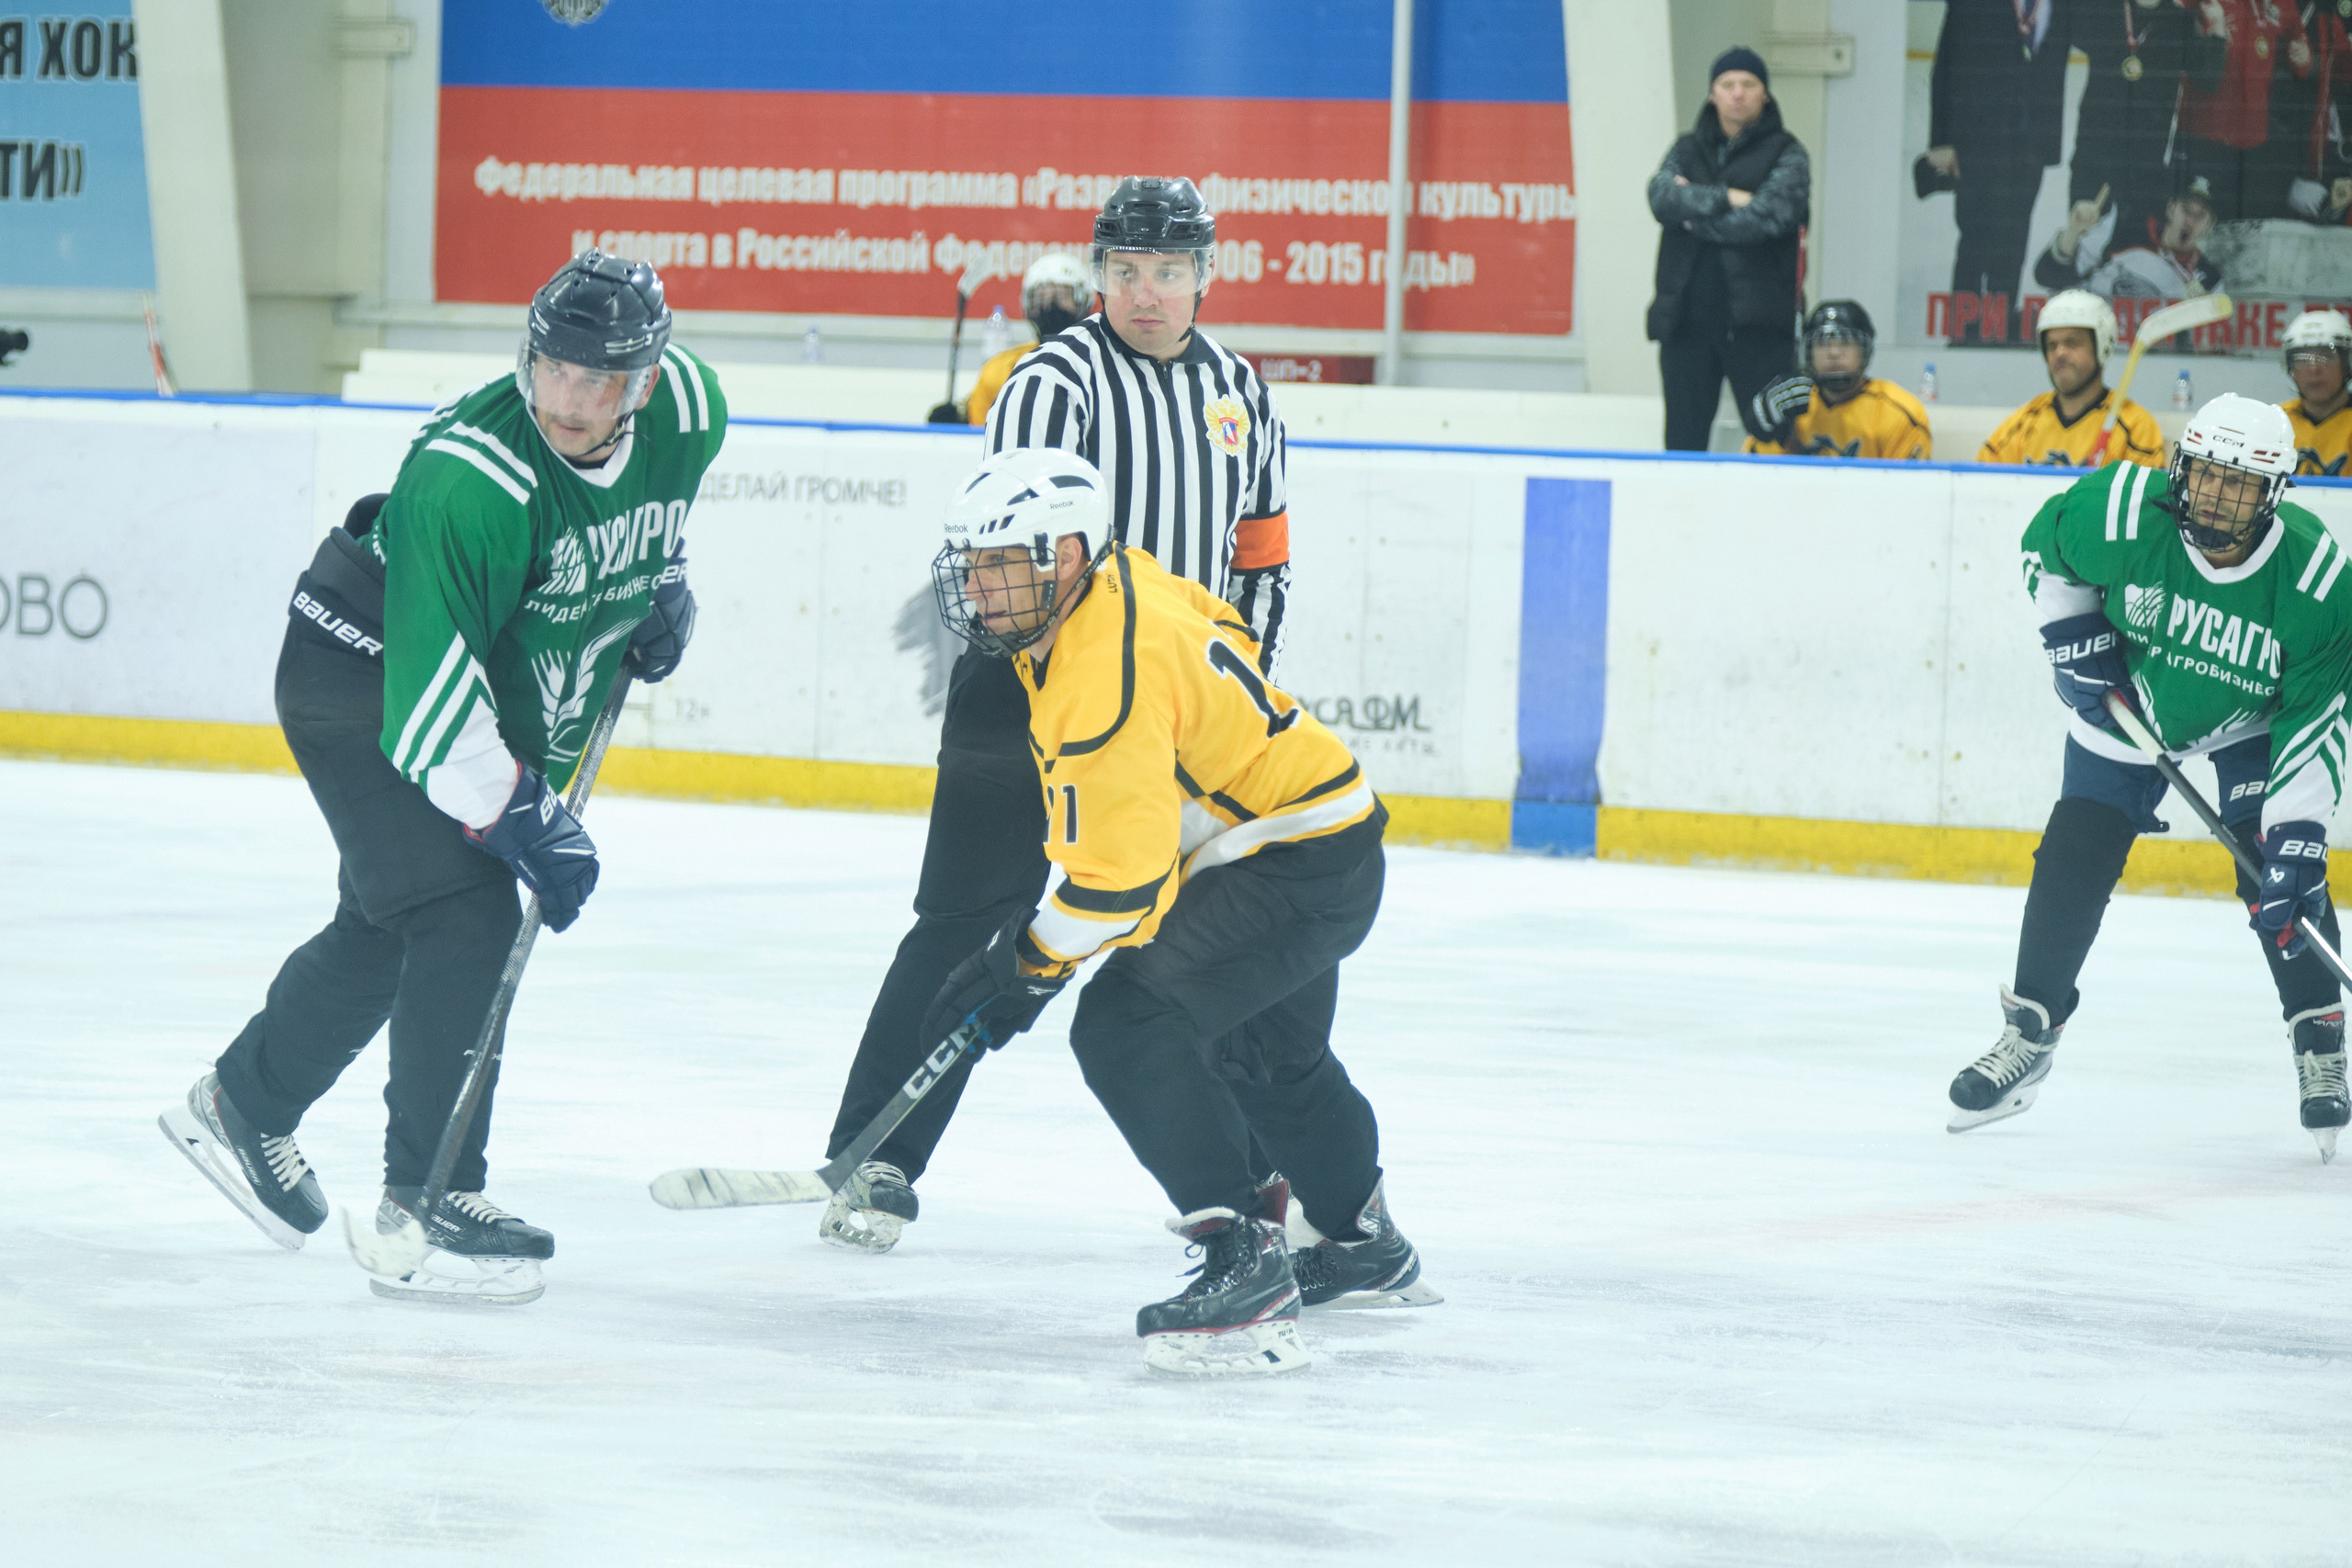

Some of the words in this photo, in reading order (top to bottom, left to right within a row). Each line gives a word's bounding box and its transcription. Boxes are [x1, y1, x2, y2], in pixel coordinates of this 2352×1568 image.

[474, 154, 695, 203] Федеральная
[698, 166, 834, 207] целевая
[838, 169, 1018, 210] программа
[711, 232, 733, 268] в
[736, 227, 930, 274] Российской
[1285, 240, 1365, 286] 2015
[1927, 291, 2008, 342] ПРИ
[2212, 434, 2245, 448] CCM
[944, 524, 968, 534] Reebok
[1049, 499, 1075, 511] Reebok
[292, 591, 384, 656] BAUER
[902, 1021, 983, 1100] CCM
